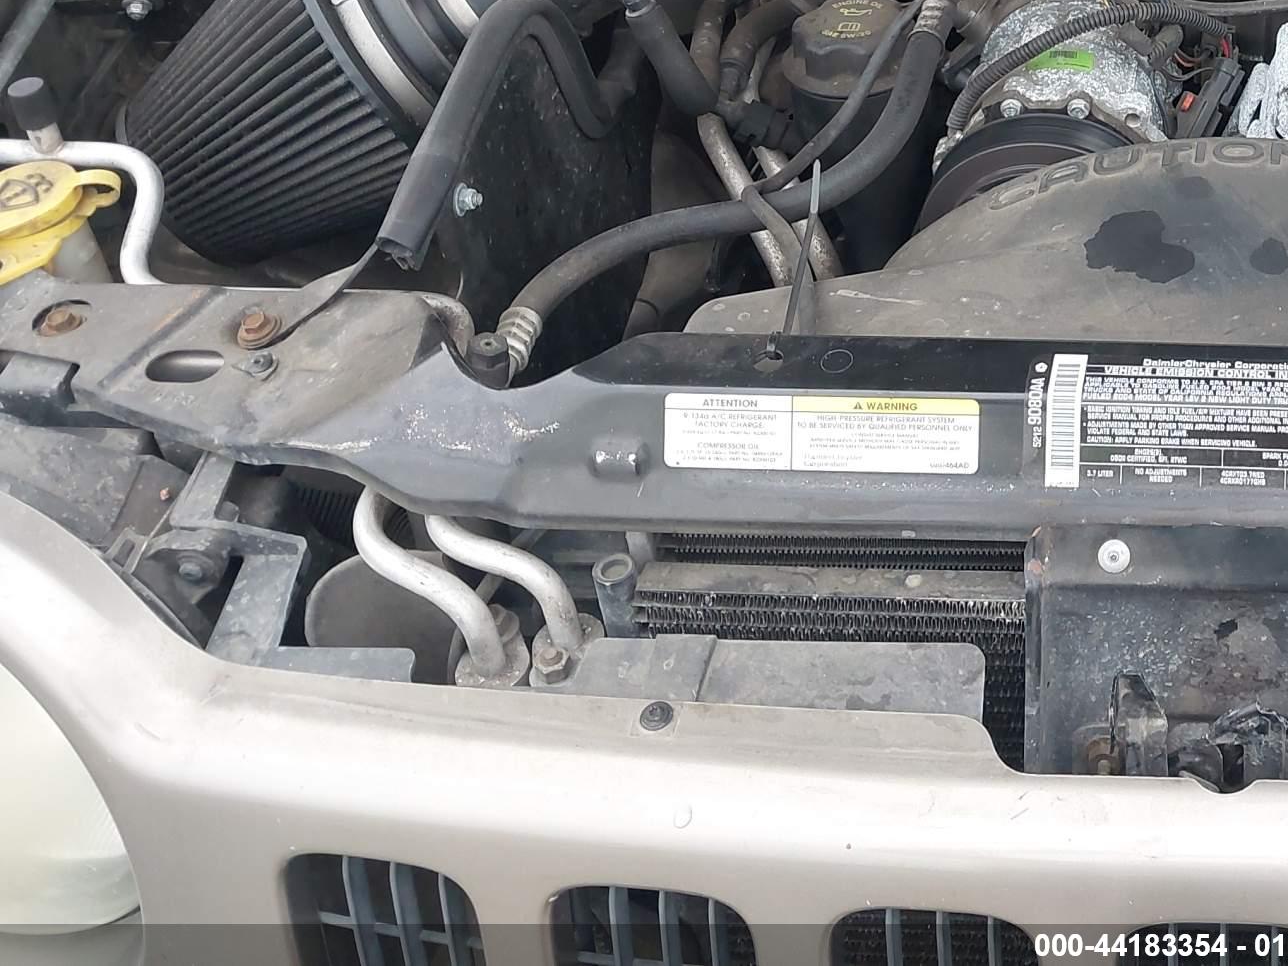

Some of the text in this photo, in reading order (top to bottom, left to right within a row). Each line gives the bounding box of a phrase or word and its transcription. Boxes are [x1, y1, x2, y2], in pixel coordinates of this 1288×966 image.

[831, 0, 869, 9] ENGINE
[1142, 359, 1230, 369] DaimlerChrysler
[1104, 366, 1151, 375] VEHICLE
[1155, 367, 1213, 377] EMISSION
[1217, 369, 1271, 378] CONTROL
[702, 398, 757, 408] ATTENTION
[866, 401, 917, 411] WARNING
[1033, 427, 1042, 447] 5212
